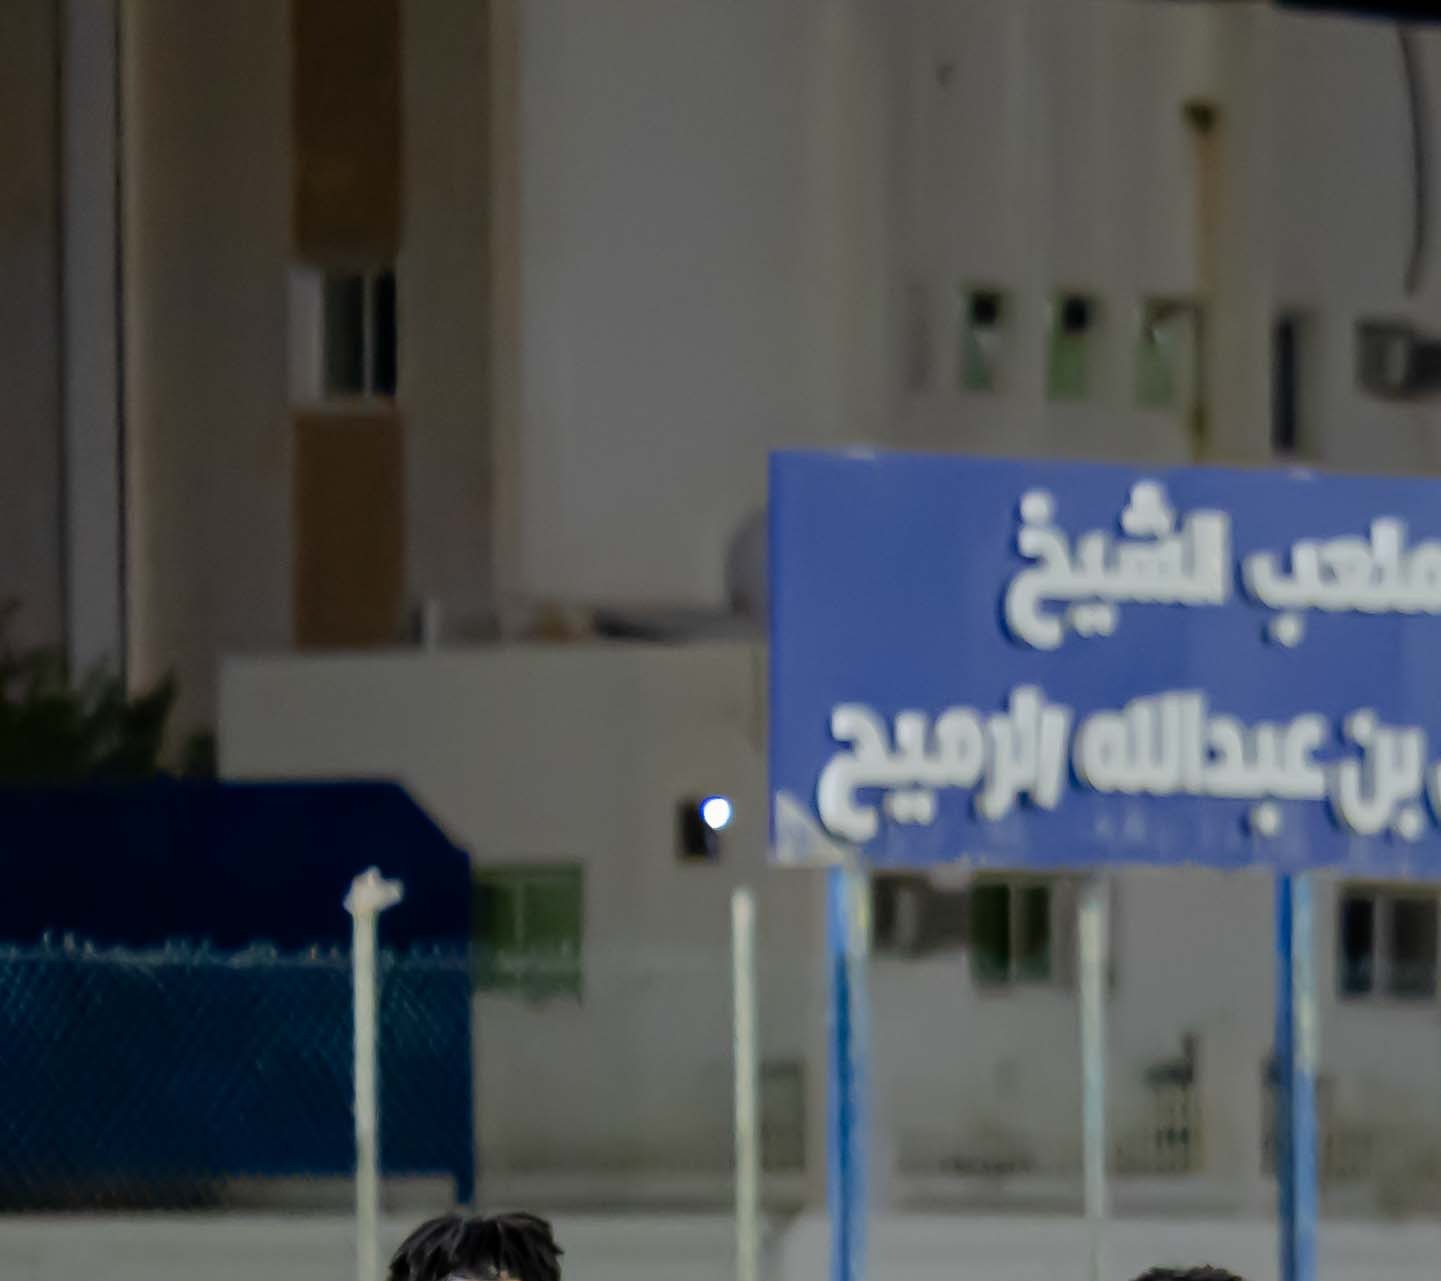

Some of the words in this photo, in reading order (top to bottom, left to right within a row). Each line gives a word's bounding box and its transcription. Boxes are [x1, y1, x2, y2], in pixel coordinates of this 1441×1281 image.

[1006, 480, 1230, 651] الشيخ
[818, 684, 1072, 844] الرميح
[1076, 690, 1327, 837] عبدالله
[1335, 708, 1424, 841] بن
